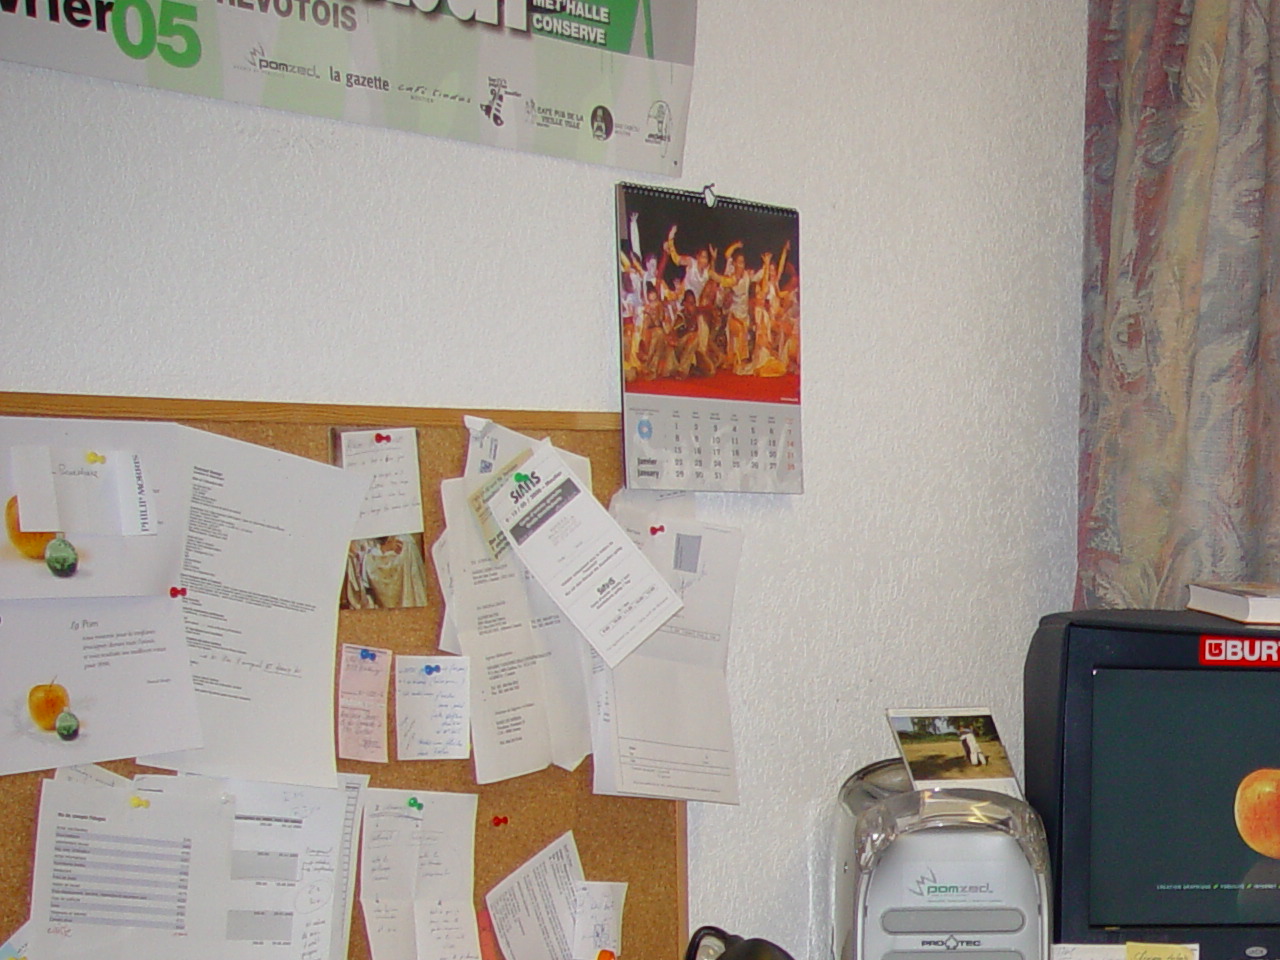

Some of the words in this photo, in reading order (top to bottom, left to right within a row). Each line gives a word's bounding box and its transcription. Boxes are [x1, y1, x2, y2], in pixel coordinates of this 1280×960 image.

[110, 0, 202, 69] 05
[531, 13, 607, 45] CONSERVE
[329, 65, 342, 83] la
[345, 73, 390, 92] gazette
[927, 882, 990, 896] pomzed
